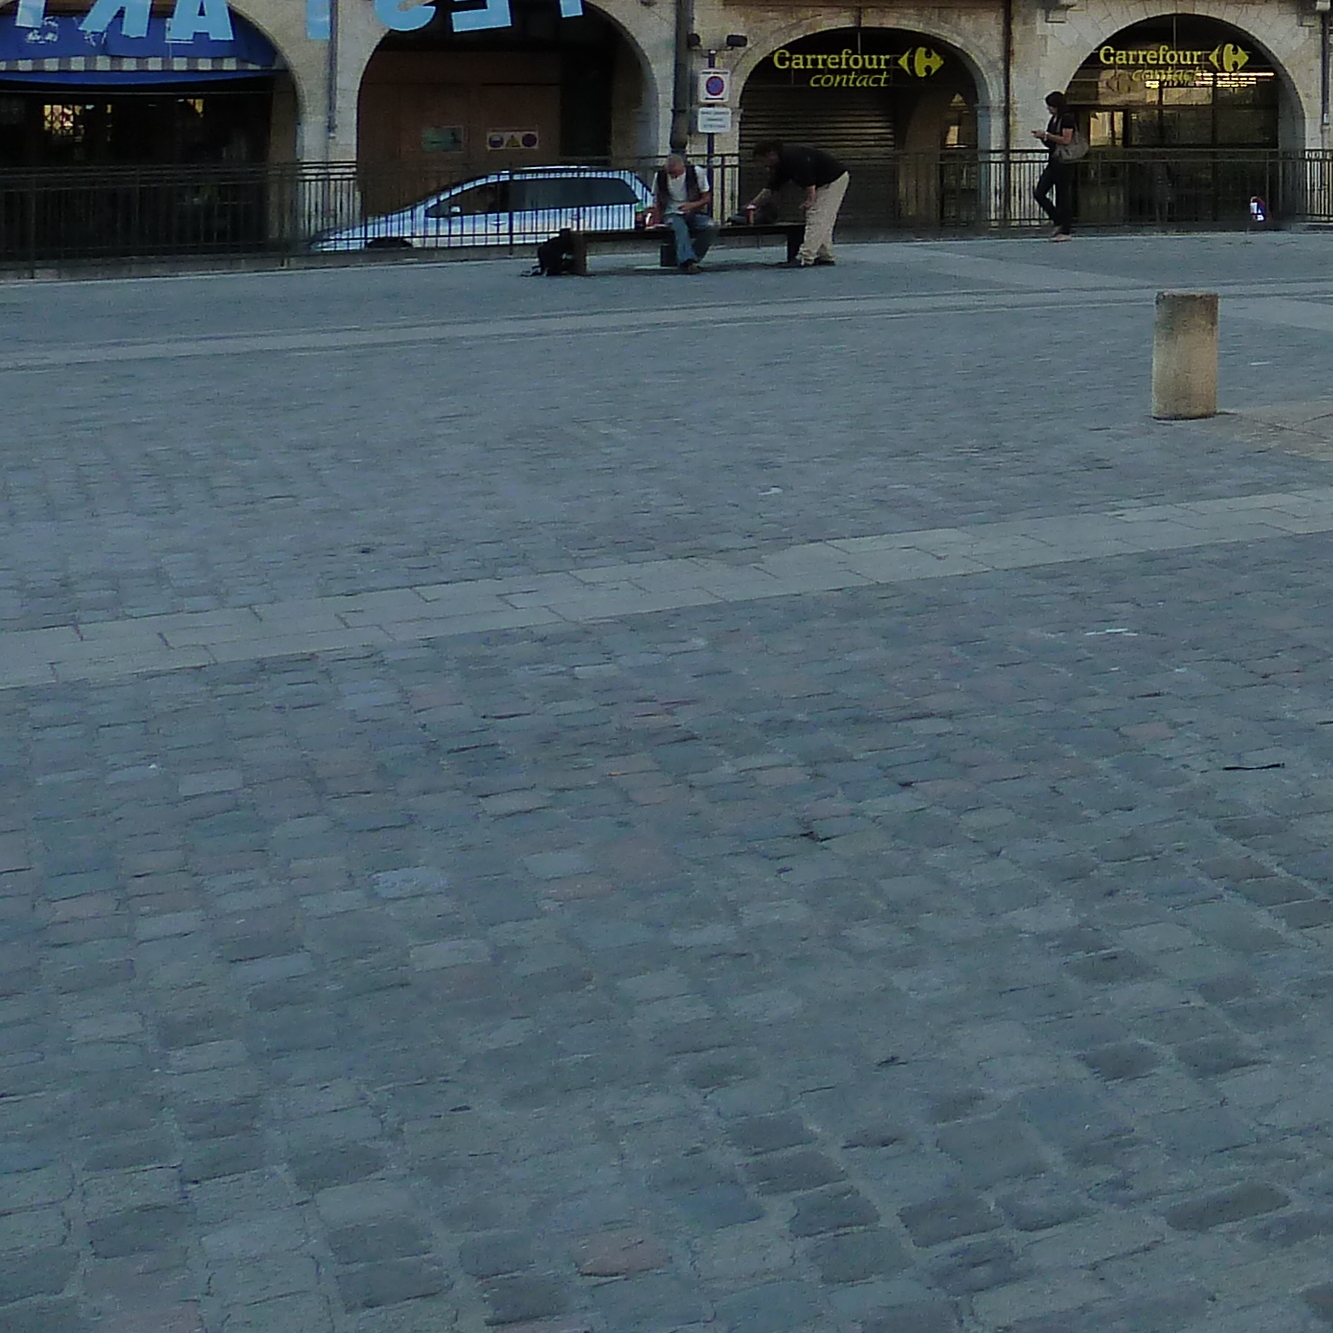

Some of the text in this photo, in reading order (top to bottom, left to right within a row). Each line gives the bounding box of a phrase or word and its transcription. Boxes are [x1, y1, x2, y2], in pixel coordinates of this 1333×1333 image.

[773, 48, 890, 70] Carrefour
[1100, 45, 1202, 65] Carrefour
[809, 71, 891, 88] contact
